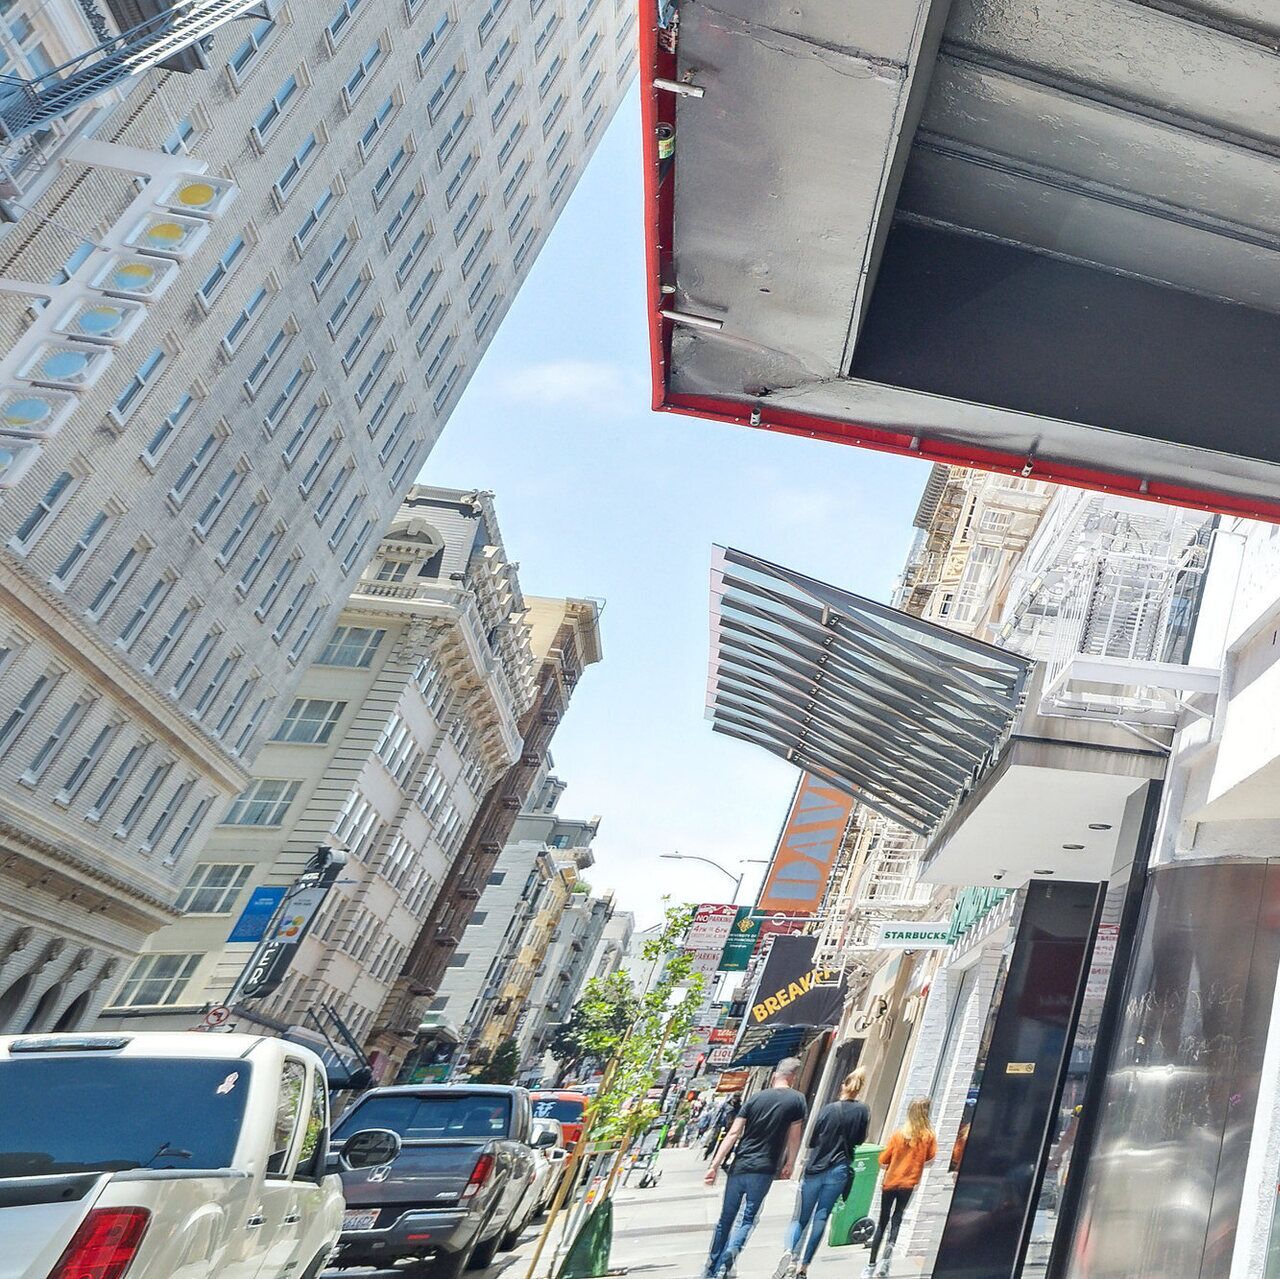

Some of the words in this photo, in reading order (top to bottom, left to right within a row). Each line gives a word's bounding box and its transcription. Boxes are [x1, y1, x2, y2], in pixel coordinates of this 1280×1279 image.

[696, 914, 708, 922] NO
[709, 915, 732, 923] PARKING
[884, 931, 947, 940] STARBUCKS
